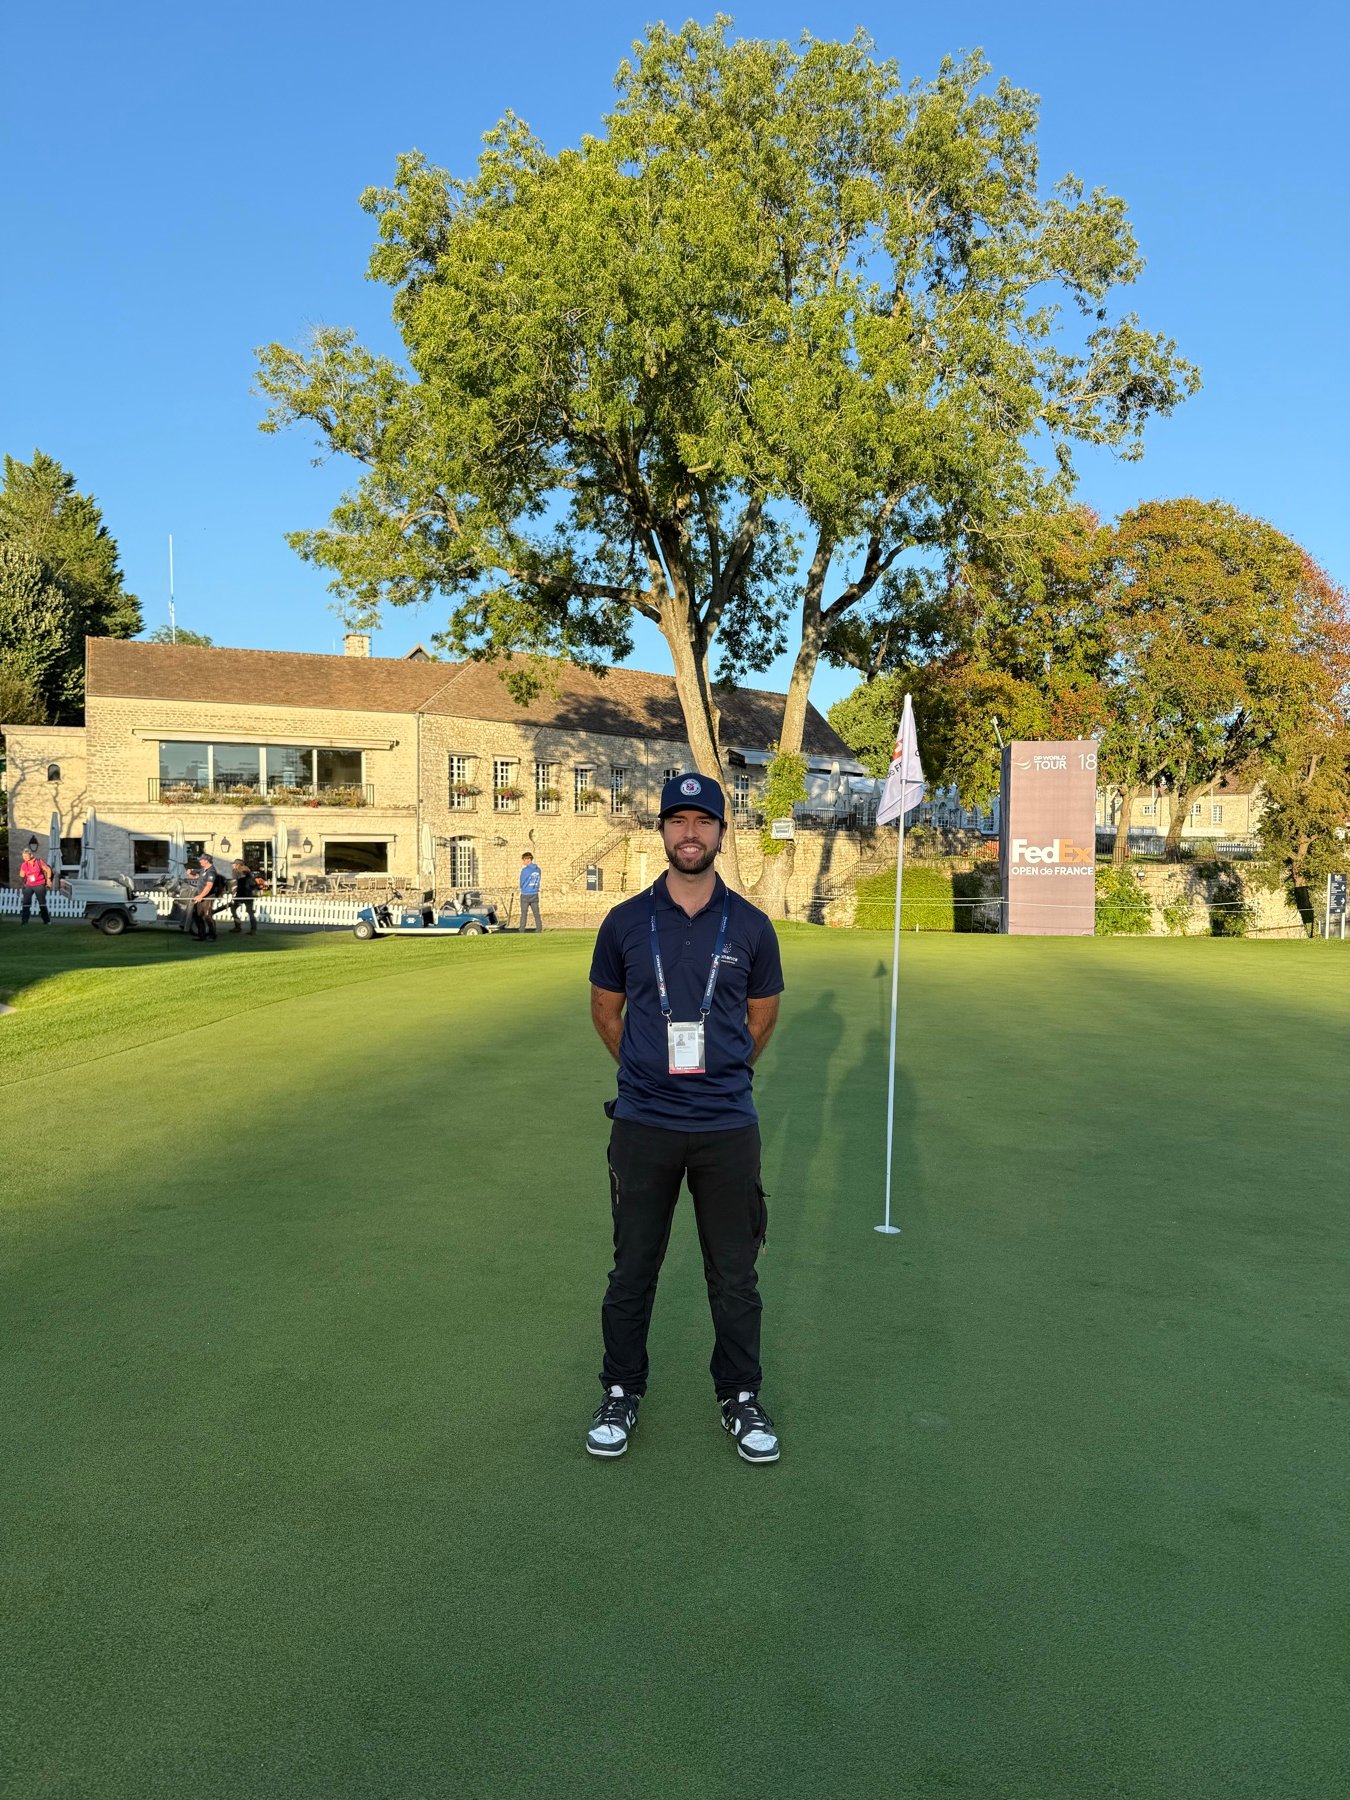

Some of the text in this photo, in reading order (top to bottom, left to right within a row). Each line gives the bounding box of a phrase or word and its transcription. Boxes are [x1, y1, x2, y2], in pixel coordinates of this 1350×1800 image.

[1034, 761, 1067, 771] TOUR
[1078, 753, 1098, 770] 18
[1012, 838, 1094, 863] FedEx
[1011, 866, 1094, 876] OPEN de FRANCE
